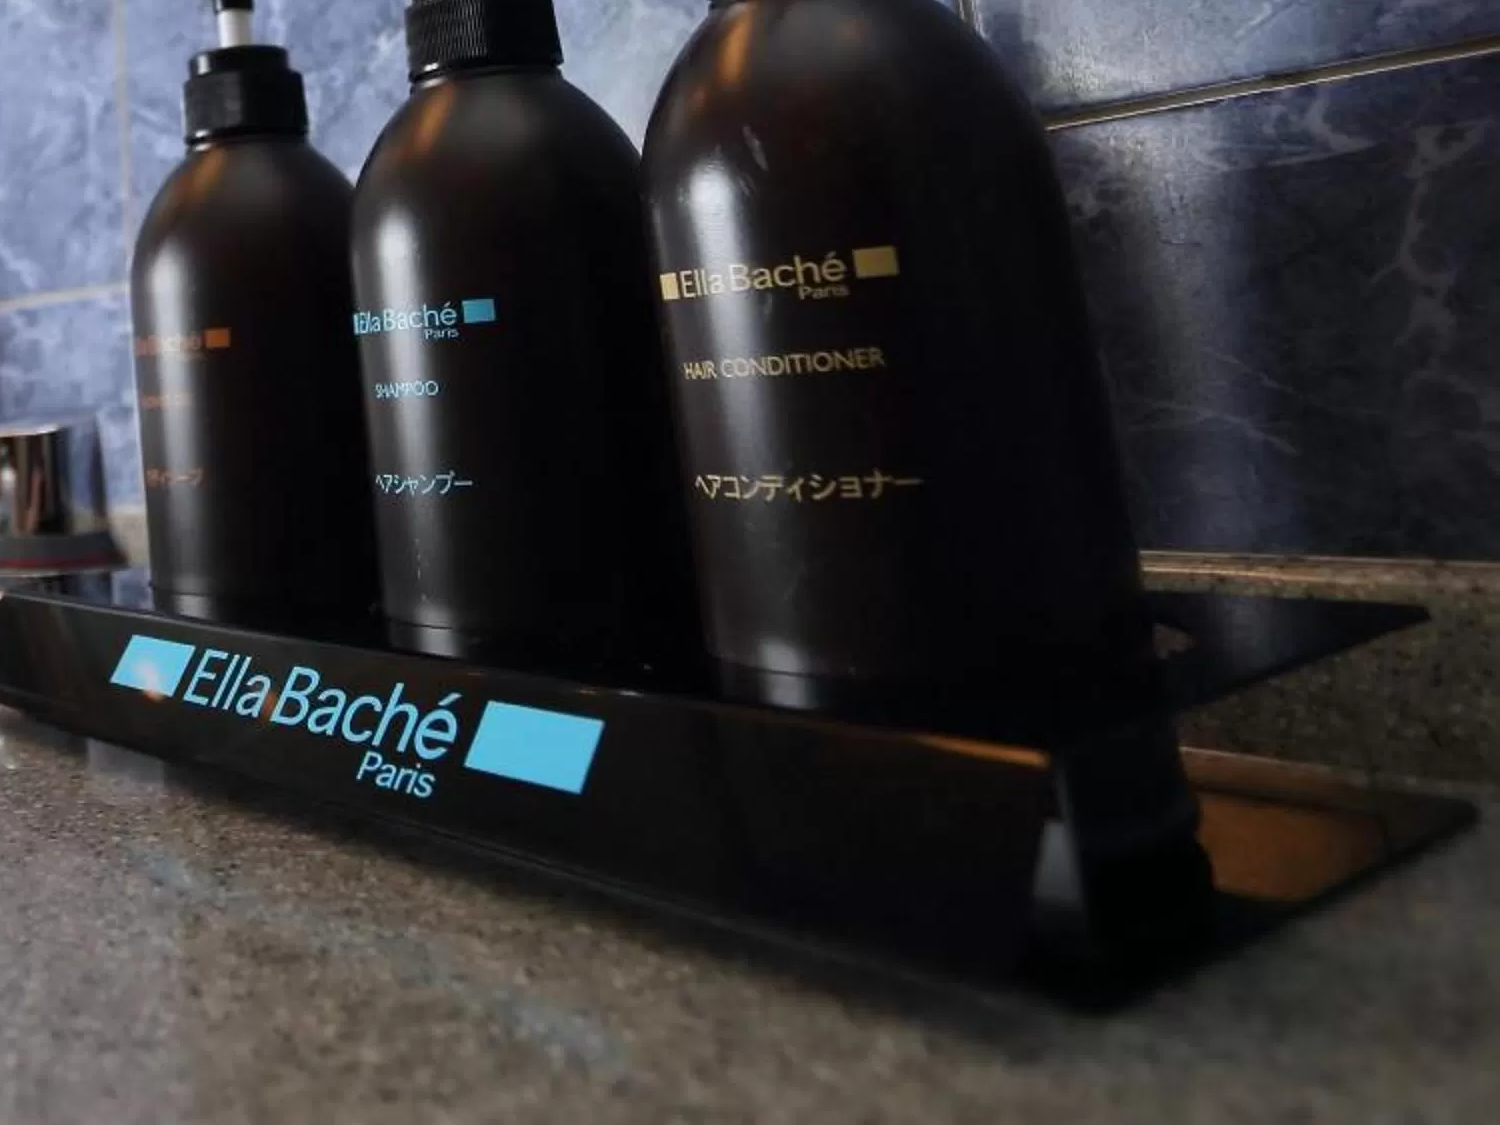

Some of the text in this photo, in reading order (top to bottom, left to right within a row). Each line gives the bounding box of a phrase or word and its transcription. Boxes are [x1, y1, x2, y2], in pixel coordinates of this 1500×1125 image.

[680, 250, 848, 299] Ella Baché
[799, 285, 849, 300] Paris
[382, 301, 458, 332] Baché
[424, 328, 460, 340] Paris
[683, 347, 885, 380] HAIR CONDITIONER
[375, 380, 439, 399] SHAMPOO
[375, 469, 474, 498] ヘアシャンプー
[694, 467, 924, 502] ヘアコンディショナー
[182, 647, 463, 761] Ella Baché
[355, 749, 437, 799] Paris
